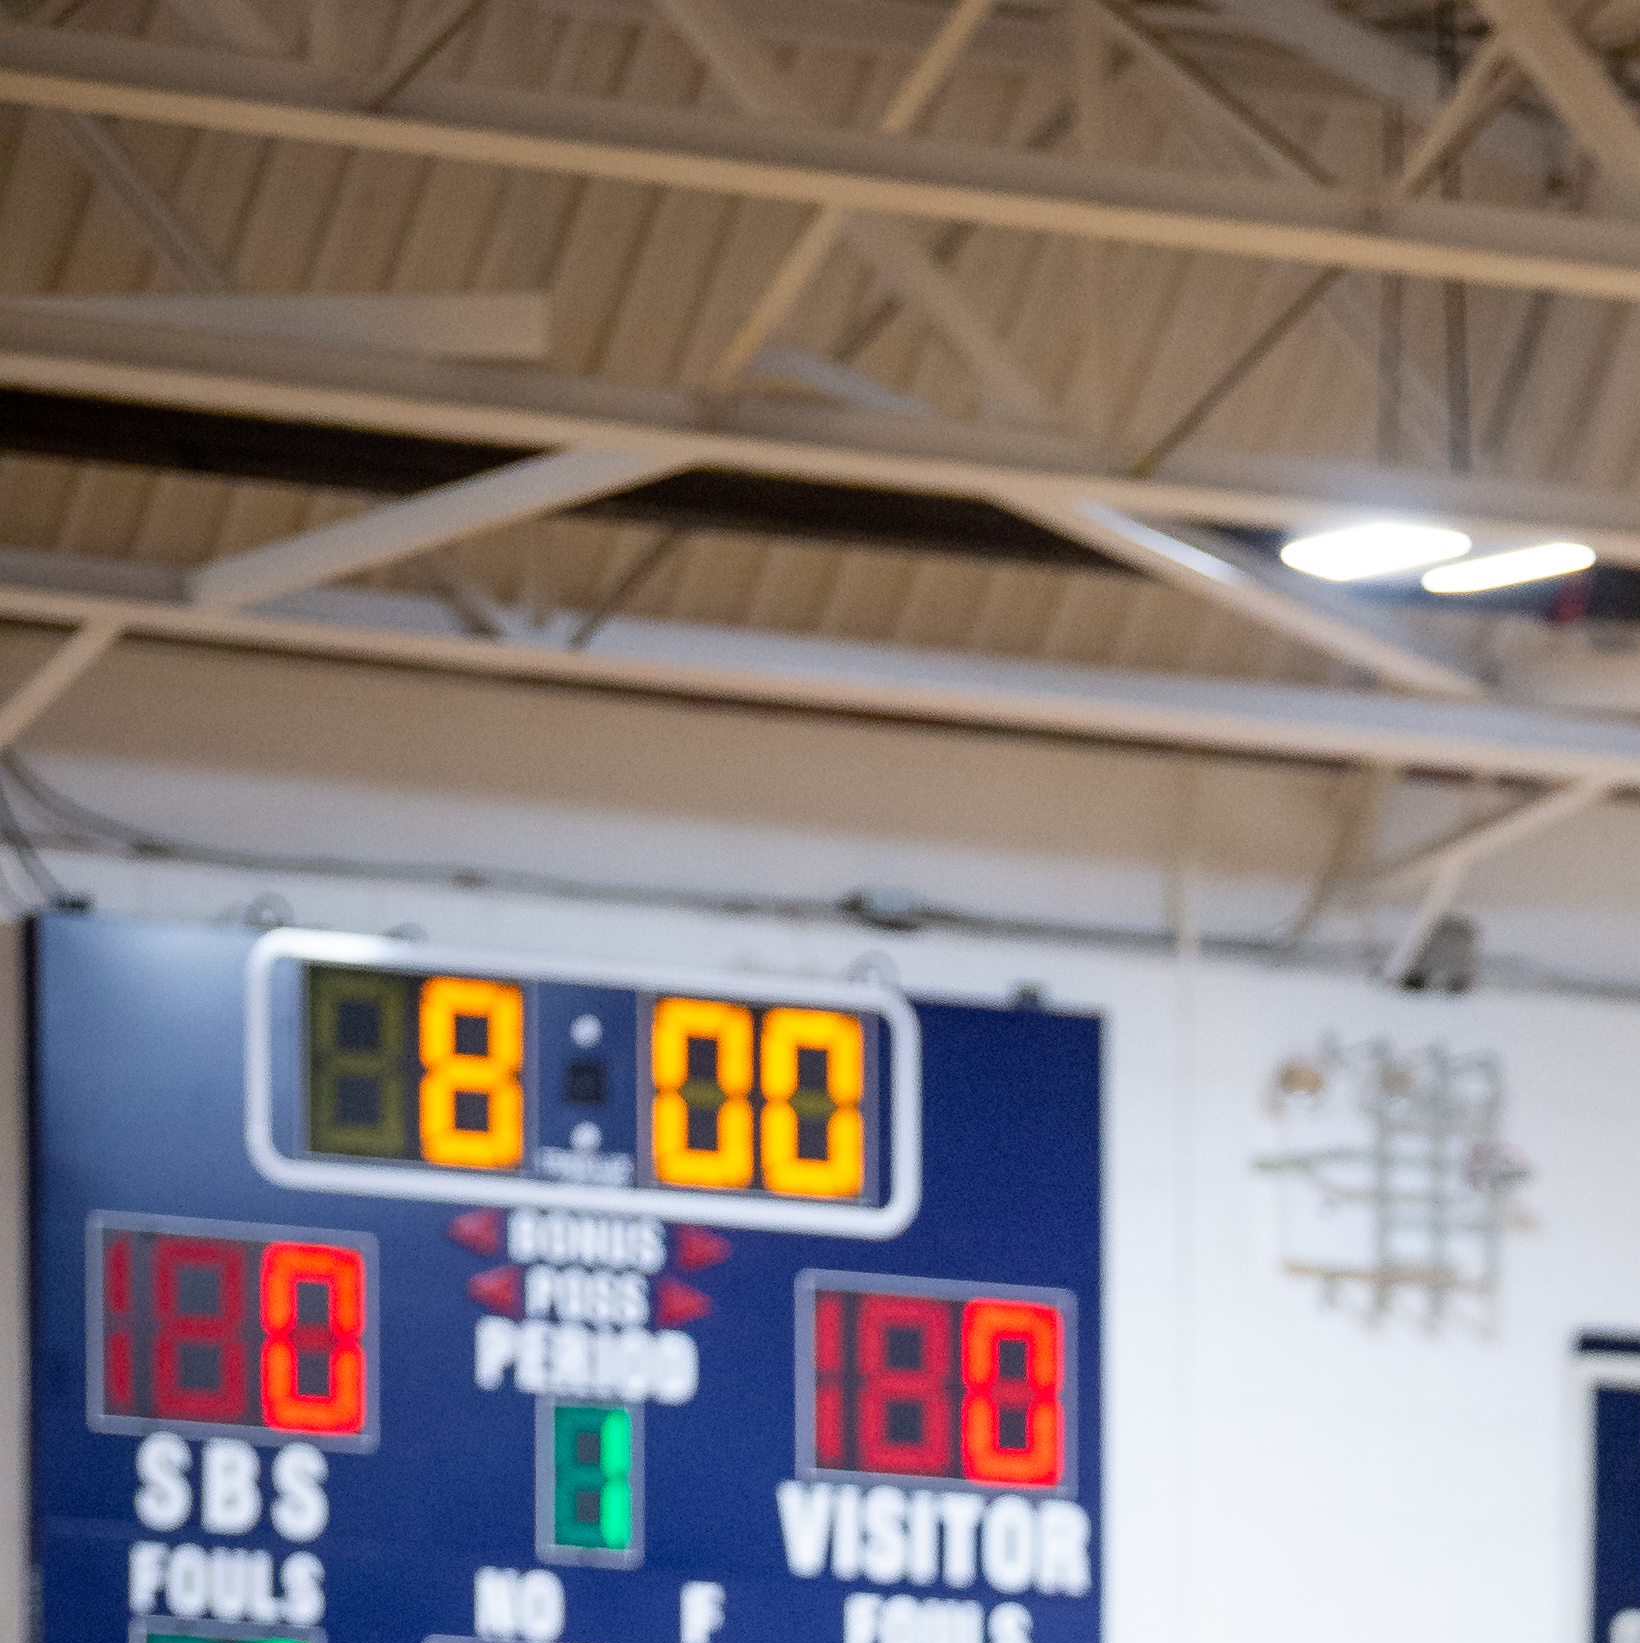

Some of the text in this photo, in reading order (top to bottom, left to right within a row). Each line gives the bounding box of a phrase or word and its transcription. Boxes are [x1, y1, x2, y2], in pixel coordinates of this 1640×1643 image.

[474, 1315, 699, 1405] PERIOD
[777, 1481, 1091, 1596] VISITOR
[129, 1541, 325, 1625] FOULS
[474, 1567, 566, 1643] NO
